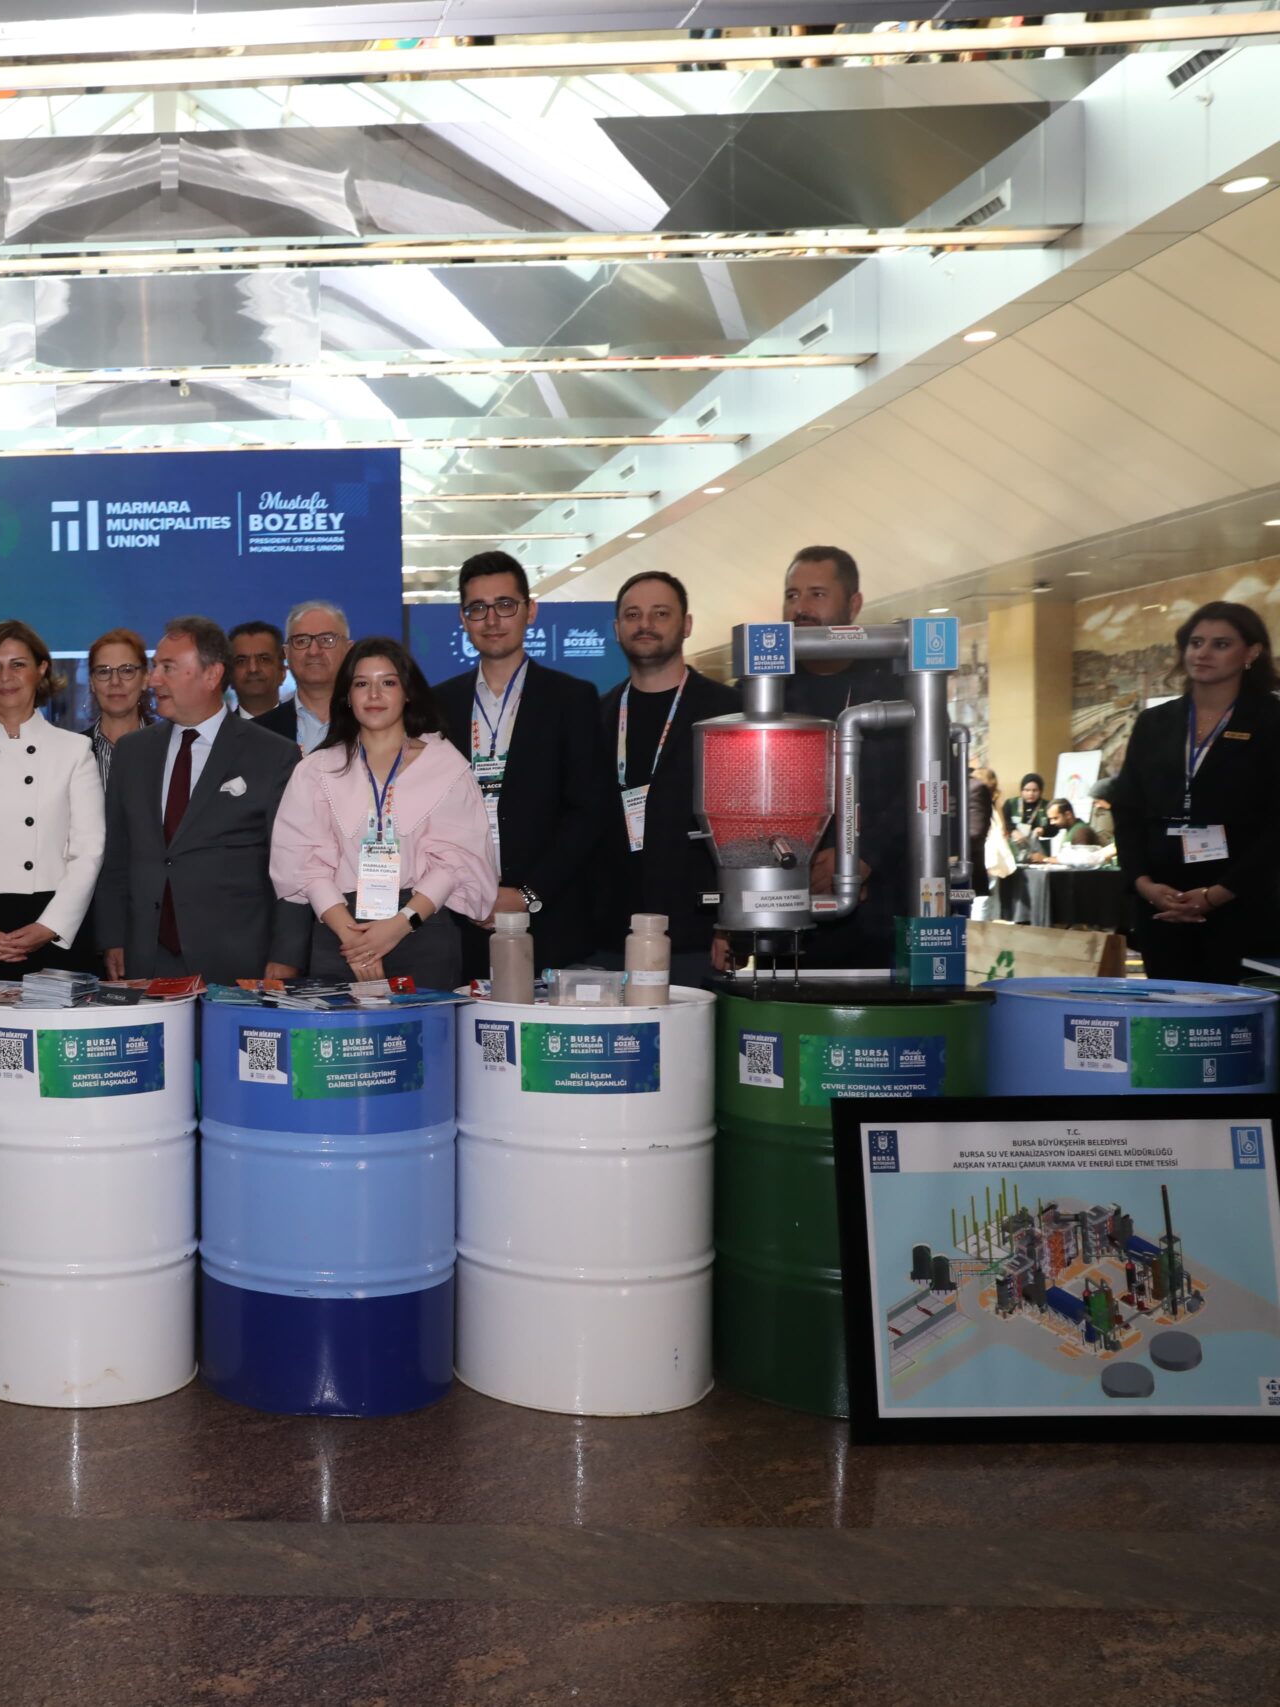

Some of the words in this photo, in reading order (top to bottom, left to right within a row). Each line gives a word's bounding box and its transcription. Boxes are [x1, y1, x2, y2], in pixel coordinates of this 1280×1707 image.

[106, 500, 191, 515] MARMARA
[259, 491, 328, 514] Mustafa
[106, 516, 231, 532] MUNICIPALITIES
[249, 513, 345, 532] BOZBEY
[106, 534, 160, 548] UNION
[249, 545, 315, 553] MUNICIPALITIES
[317, 544, 344, 552] UNION
[563, 638, 605, 647] BOZBEY
[1189, 1028, 1222, 1036] BURSA
[86, 1038, 117, 1046] BURSA
[342, 1038, 374, 1046] BURSA
[570, 1035, 603, 1043] BURSA
[855, 1049, 889, 1057] BURSA
[73, 1072, 102, 1080] KENTSEL
[104, 1070, 137, 1079] DÖNÜŞÜM
[326, 1072, 358, 1081] STRATEJİ
[359, 1070, 397, 1079] GELİŞTİRME
[591, 1072, 612, 1080] İŞLEM
[72, 1080, 99, 1088] DAİRESİ
[100, 1077, 138, 1087] BAŞKANLIĞI
[328, 1080, 356, 1088] DAİRESİ
[357, 1077, 396, 1088] BAŞKANLIĞI
[555, 1079, 583, 1087] DAİRESİ
[585, 1078, 627, 1088] BAŞKANLIĞI
[821, 1083, 846, 1091] ÇEVRE
[1038, 1138, 1086, 1148] BÜYÜKŞEHİR
[1088, 1138, 1127, 1146] BELEDİYESİ
[1010, 1149, 1065, 1157] KANALİZASYON
[1067, 1148, 1097, 1157] İDARESİ
[1124, 1147, 1173, 1156] MÜDÜRLÜĞÜ
[953, 1162, 985, 1170] AKIŞKAN
[1019, 1161, 1046, 1170] ÇAMUR
[1089, 1159, 1114, 1167] ENERJİ
[1157, 1159, 1178, 1167] TESİSİ
